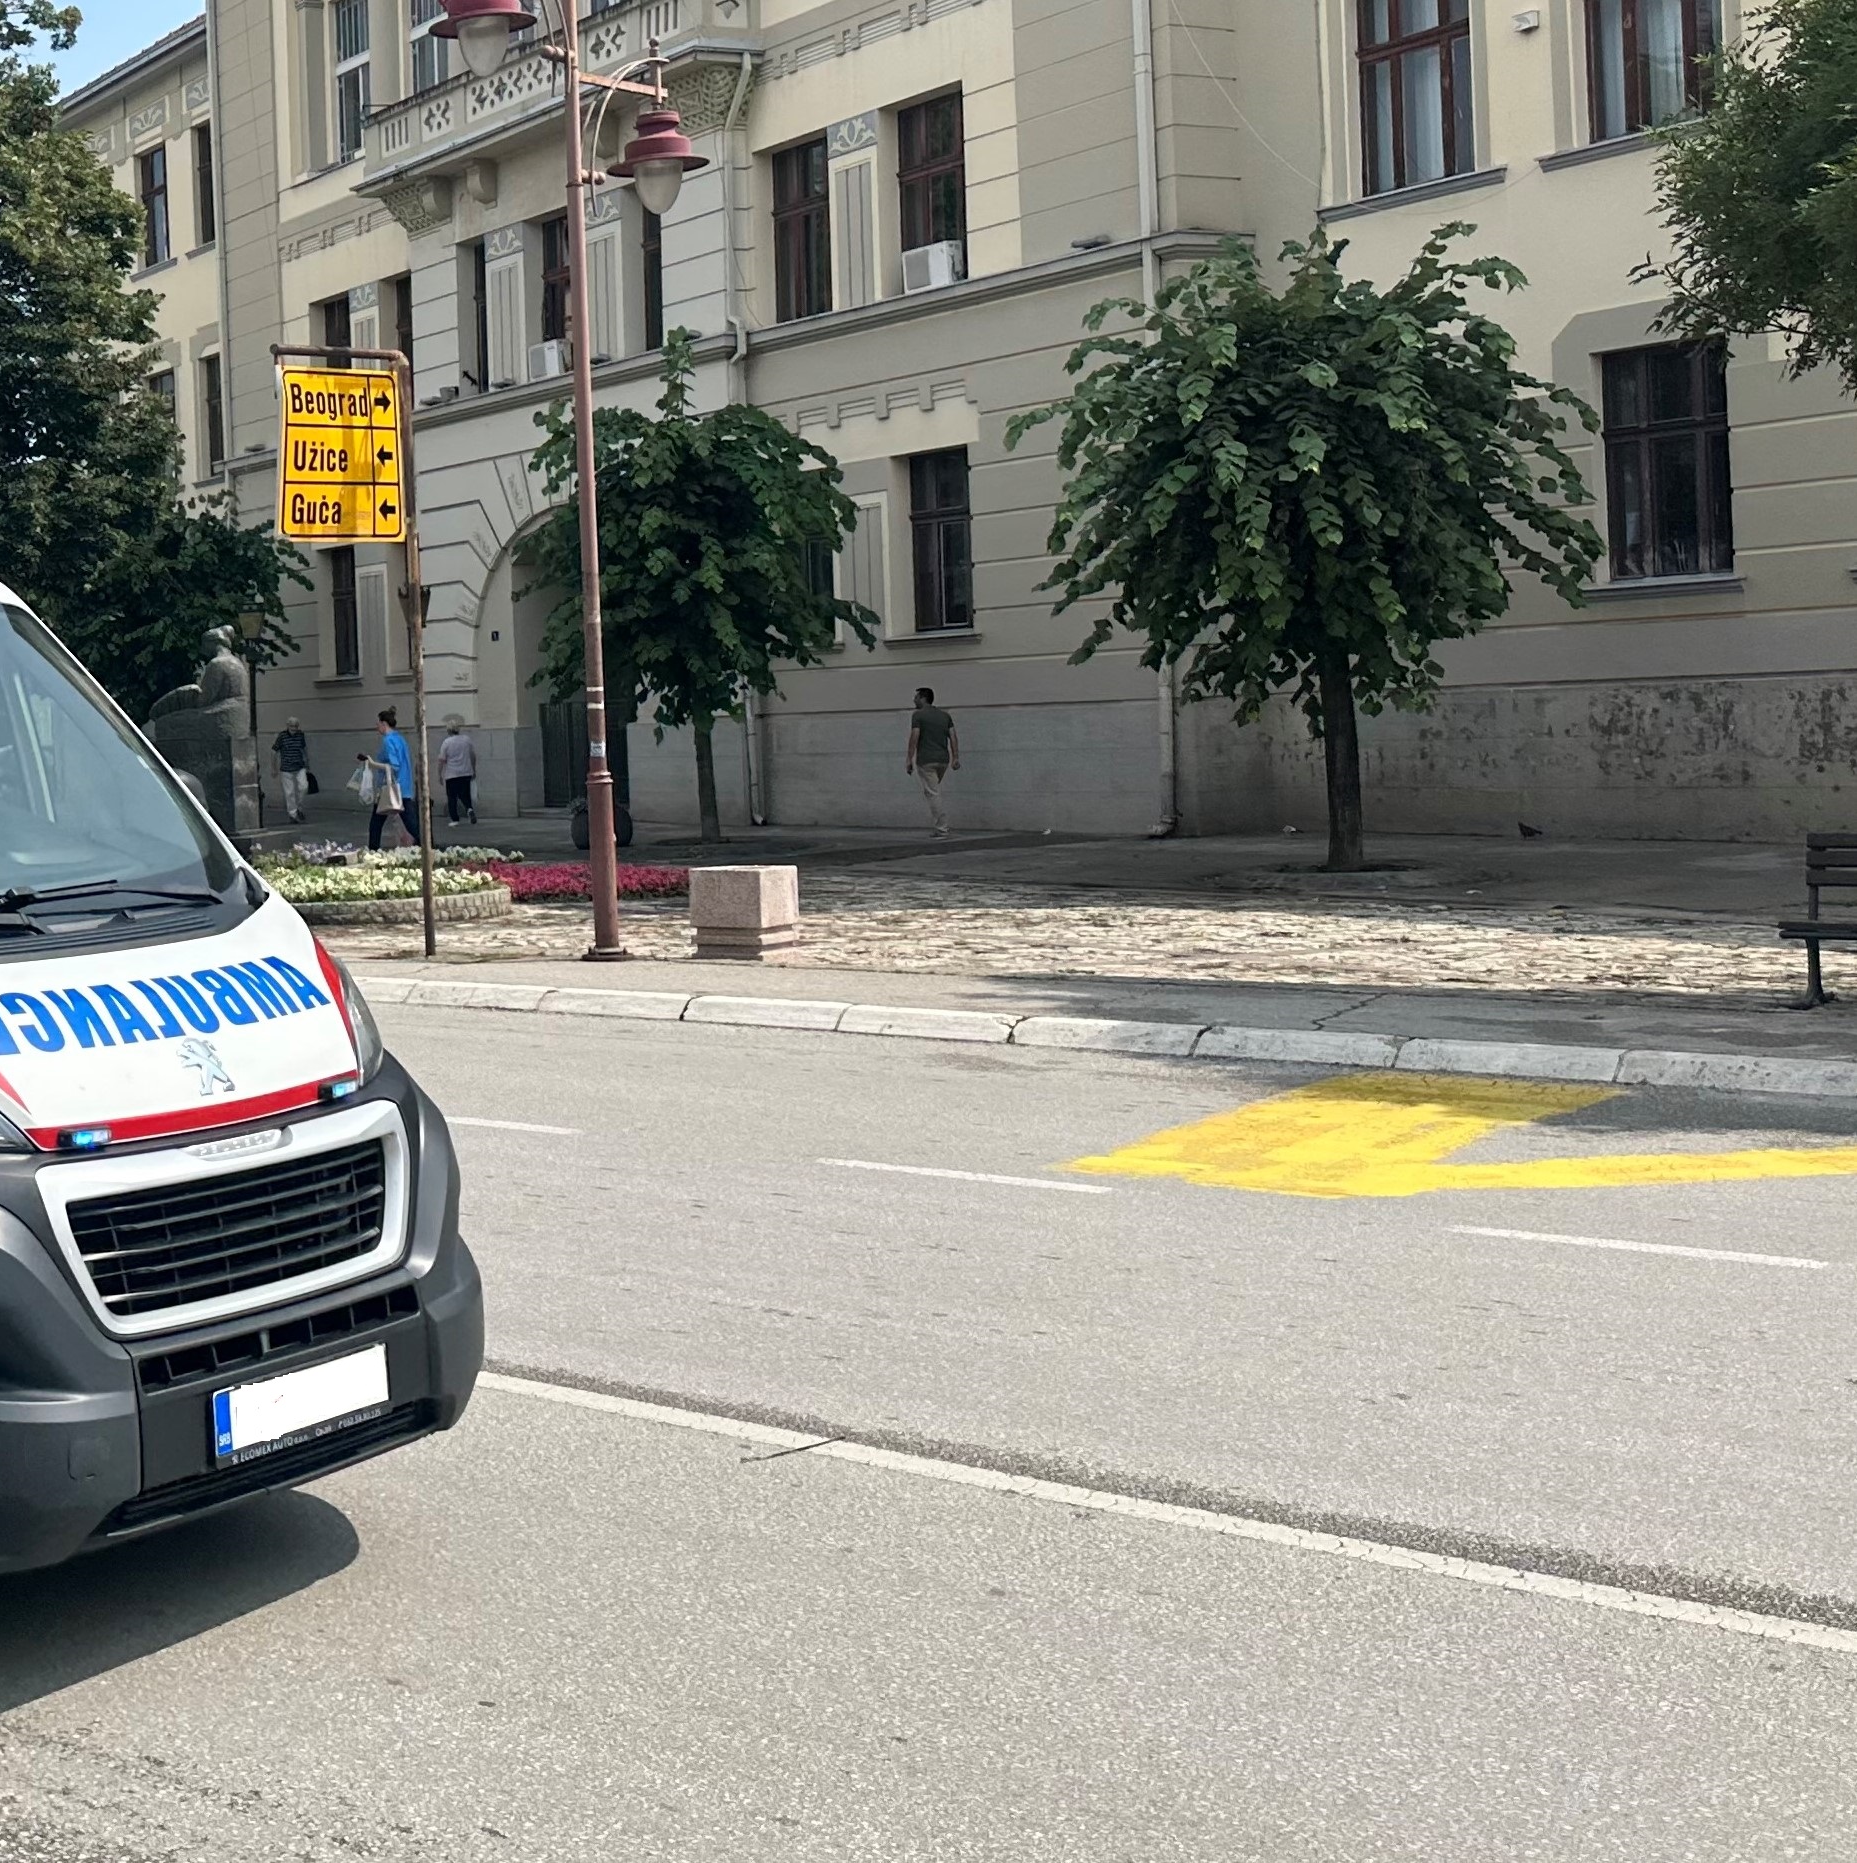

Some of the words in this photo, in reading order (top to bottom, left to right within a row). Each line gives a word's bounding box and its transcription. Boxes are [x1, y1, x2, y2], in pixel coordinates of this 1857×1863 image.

[290, 383, 369, 421] Beograd
[219, 1432, 231, 1446] SRB
[240, 1443, 271, 1463] ECOMEX
[272, 1436, 293, 1452] AUTO
